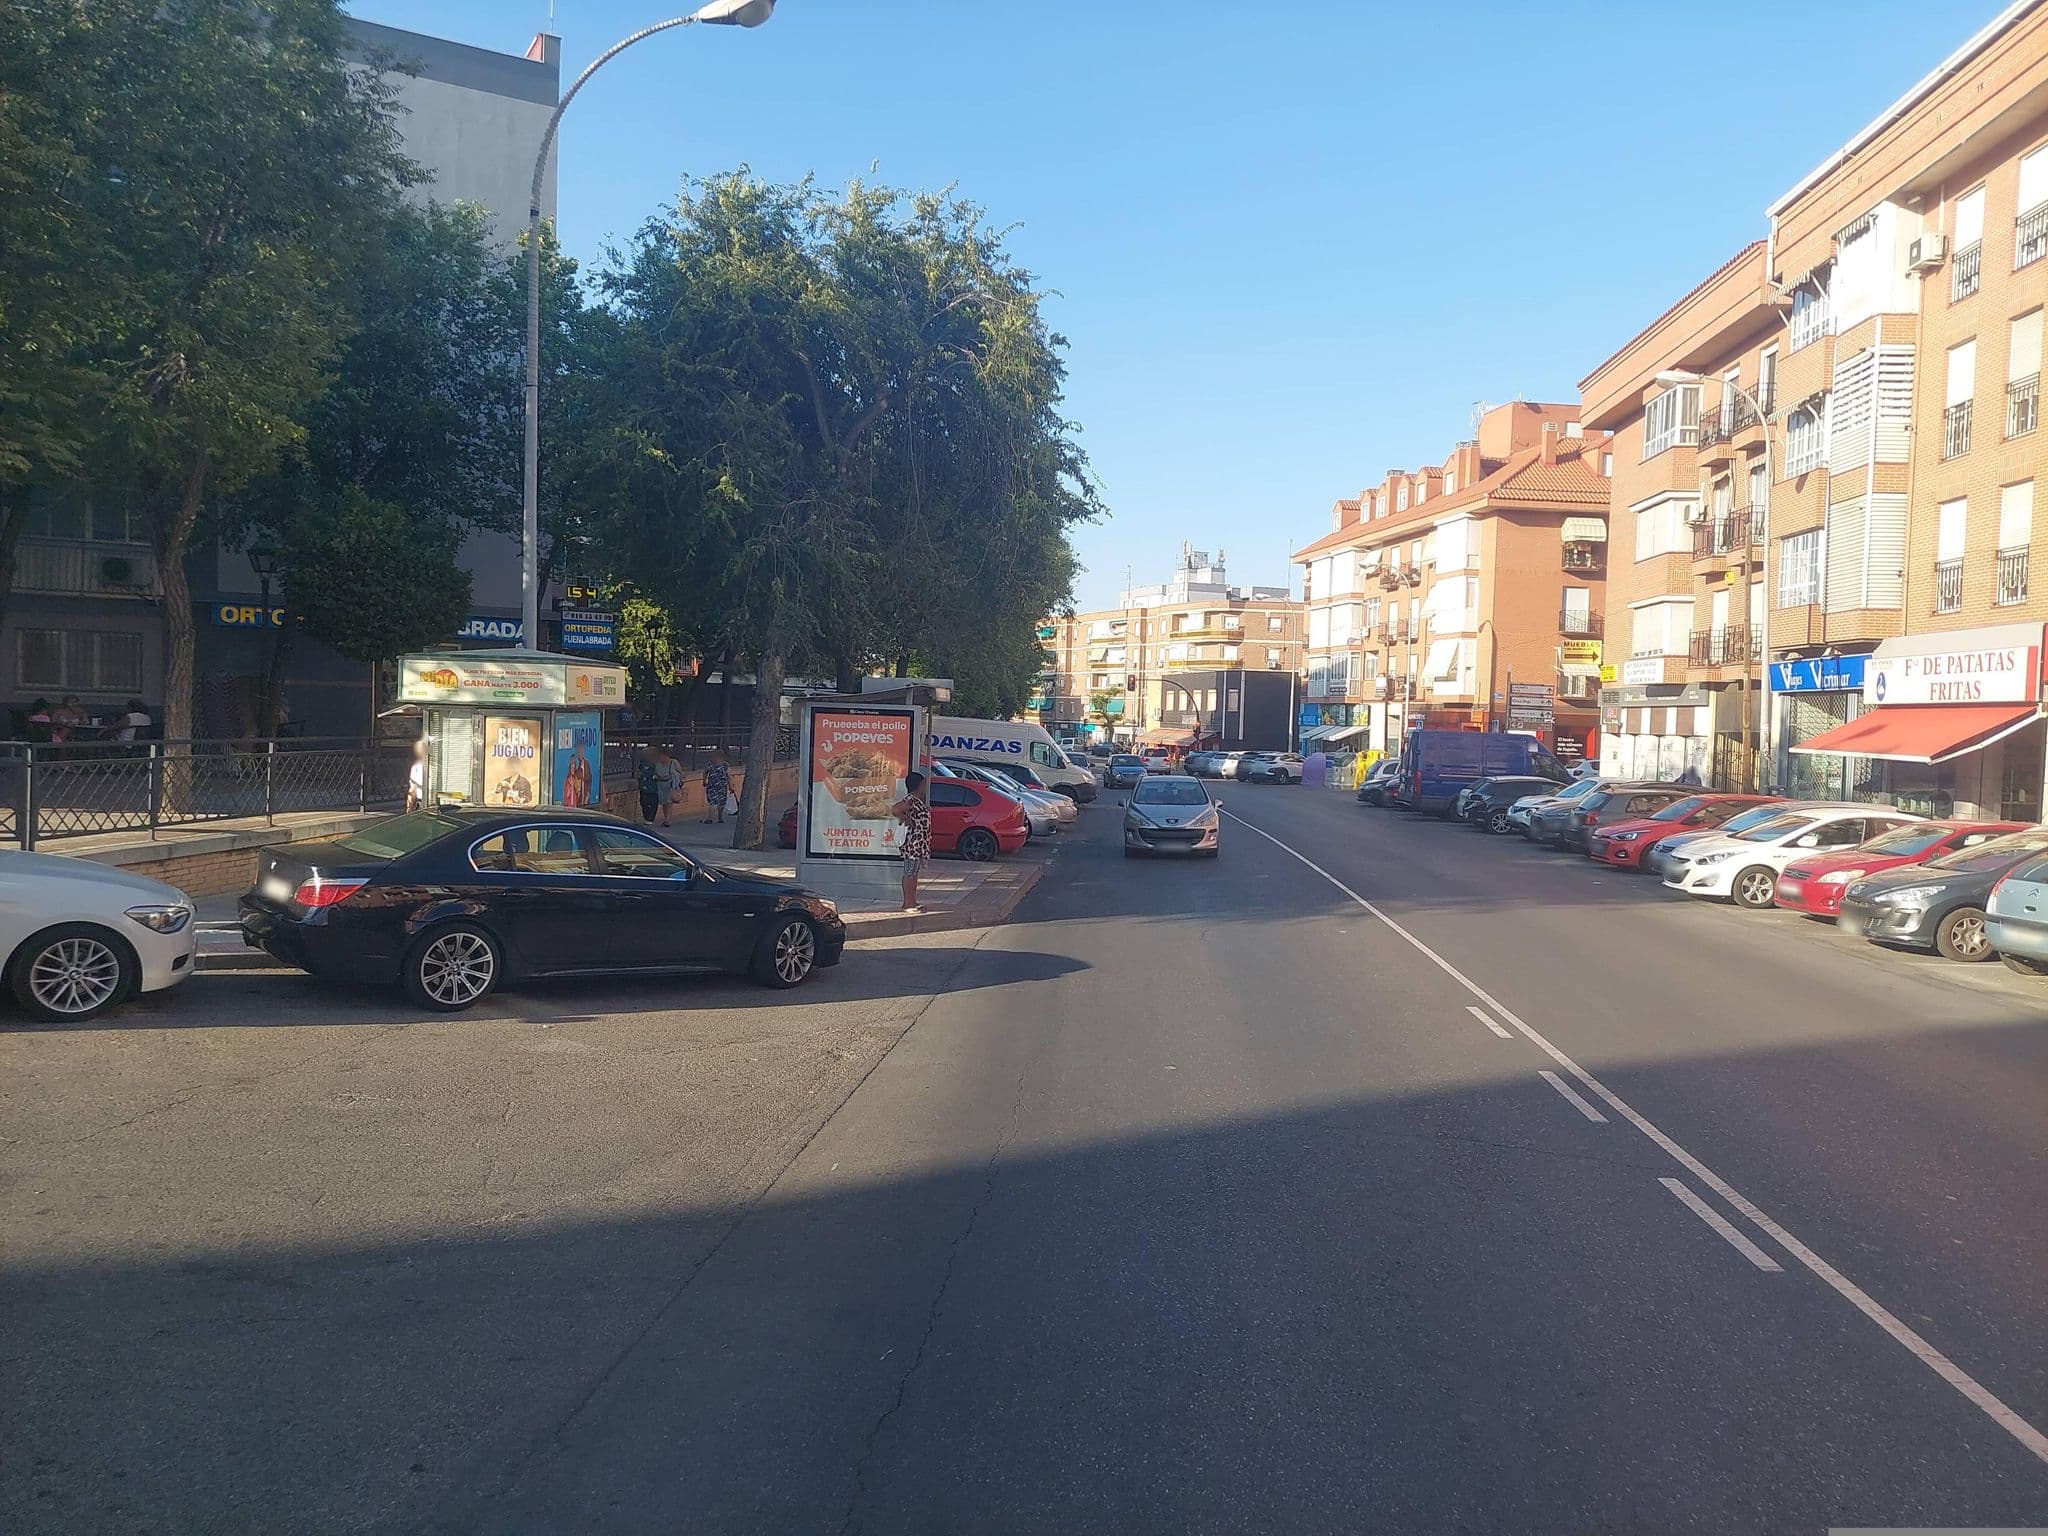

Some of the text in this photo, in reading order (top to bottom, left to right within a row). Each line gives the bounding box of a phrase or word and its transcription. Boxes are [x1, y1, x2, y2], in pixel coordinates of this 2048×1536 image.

[564, 623, 612, 634] ORTOPEDIA
[563, 634, 612, 645] FUENLABRADA
[1923, 656, 1942, 676] DE
[1946, 650, 2015, 674] PATATAS
[463, 679, 491, 687] GANA
[1930, 680, 1981, 701] FRITAS
[822, 719, 907, 731] Prueeeba el pollo
[498, 727, 529, 745] BIEN
[492, 744, 534, 758] JUGADO
[823, 827, 875, 838] JUNTO AL
[828, 838, 870, 848] TEATRO
